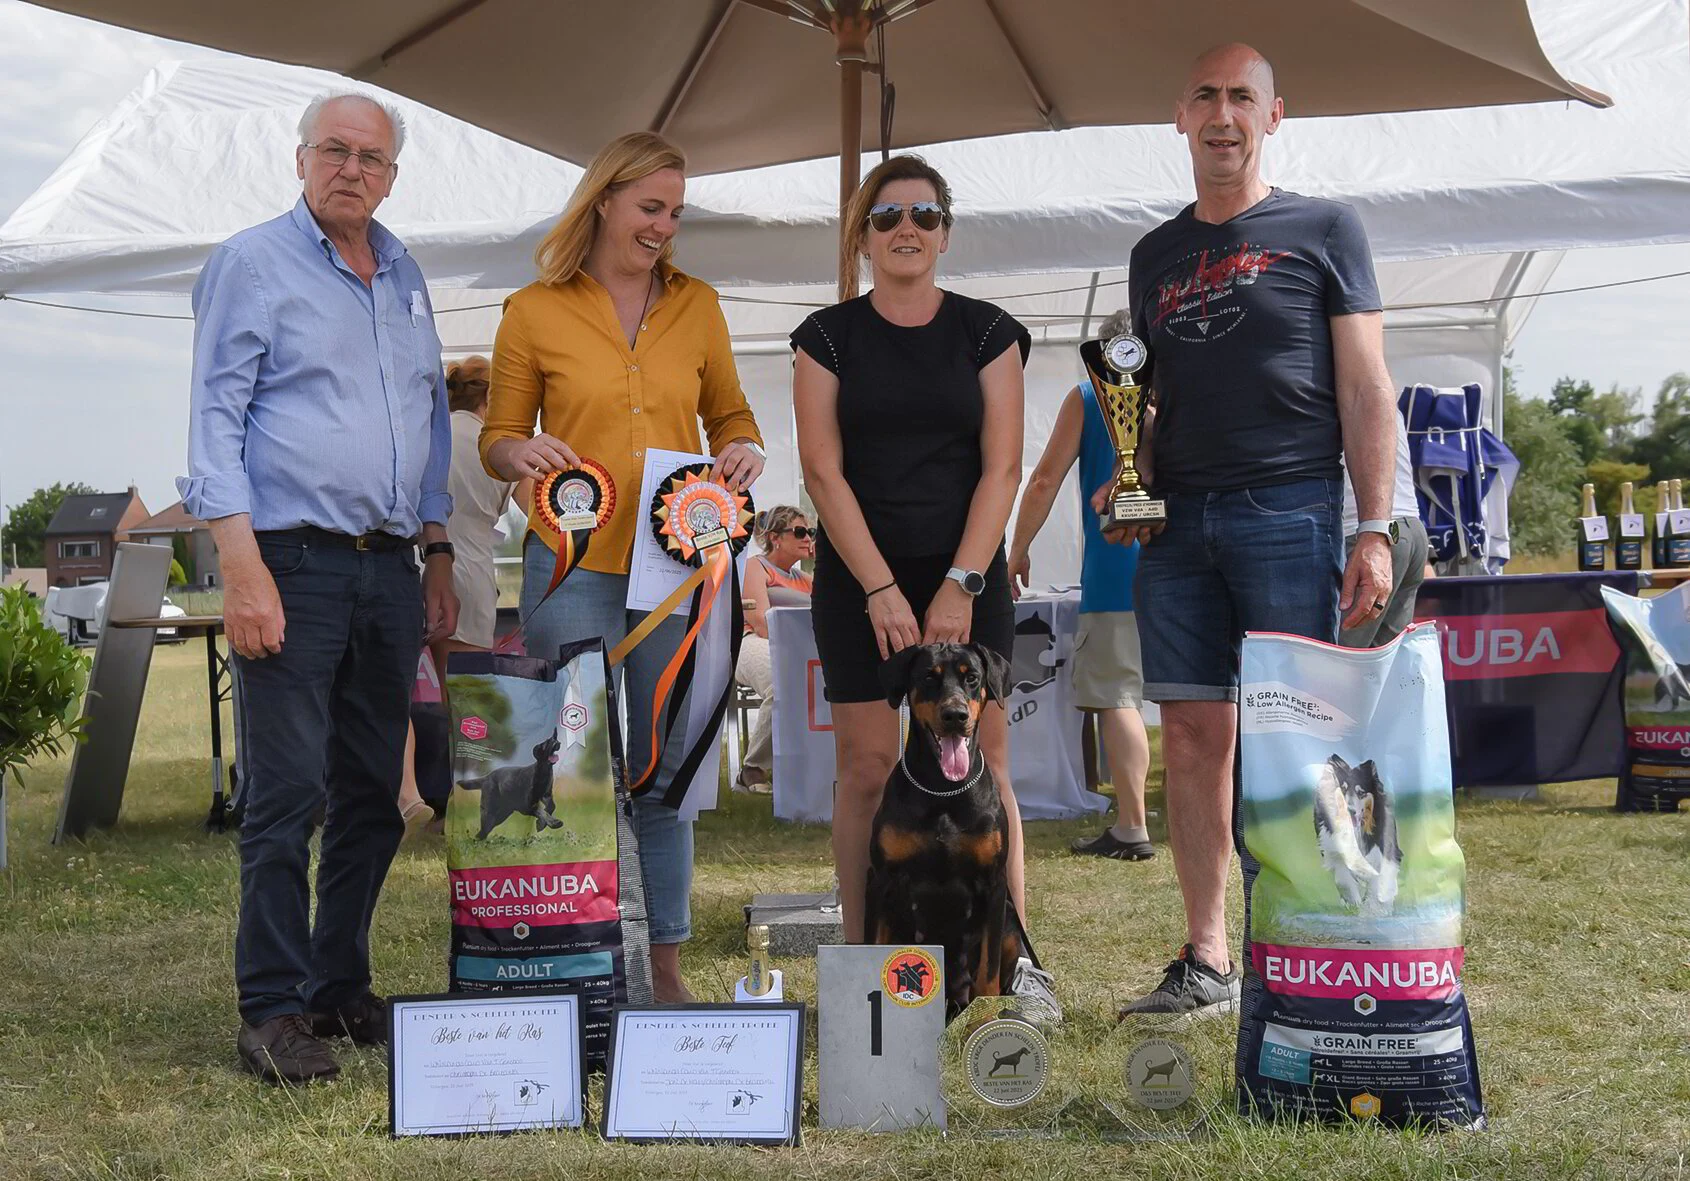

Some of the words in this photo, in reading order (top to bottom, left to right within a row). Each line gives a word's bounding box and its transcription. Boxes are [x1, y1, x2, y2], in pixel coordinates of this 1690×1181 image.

[1206, 288, 1233, 303] Edition
[1437, 626, 1561, 666] UBA
[1257, 691, 1289, 701] GRAIN
[1008, 700, 1039, 727] dD
[1276, 700, 1306, 715] Allergen
[1307, 711, 1333, 721] Recipe
[455, 874, 599, 901] EUKANUBA
[472, 902, 578, 918] PROFESSIONAL
[496, 963, 554, 979] ADULT
[1266, 955, 1457, 988] EUKANUBA
[867, 990, 882, 1056] 1
[431, 1026, 462, 1045] Beste
[468, 1030, 490, 1043] van
[495, 1022, 512, 1040] het
[517, 1022, 543, 1042] Ras
[982, 1032, 1005, 1047] DENDER
[1014, 1033, 1035, 1051] SCHELDE
[674, 1035, 705, 1053] Beste
[711, 1034, 739, 1055] Teef
[1270, 1047, 1300, 1059] ADULT
[1324, 1037, 1372, 1050] GRAIN
[1326, 1058, 1333, 1066] L
[1326, 1075, 1340, 1083] XL
